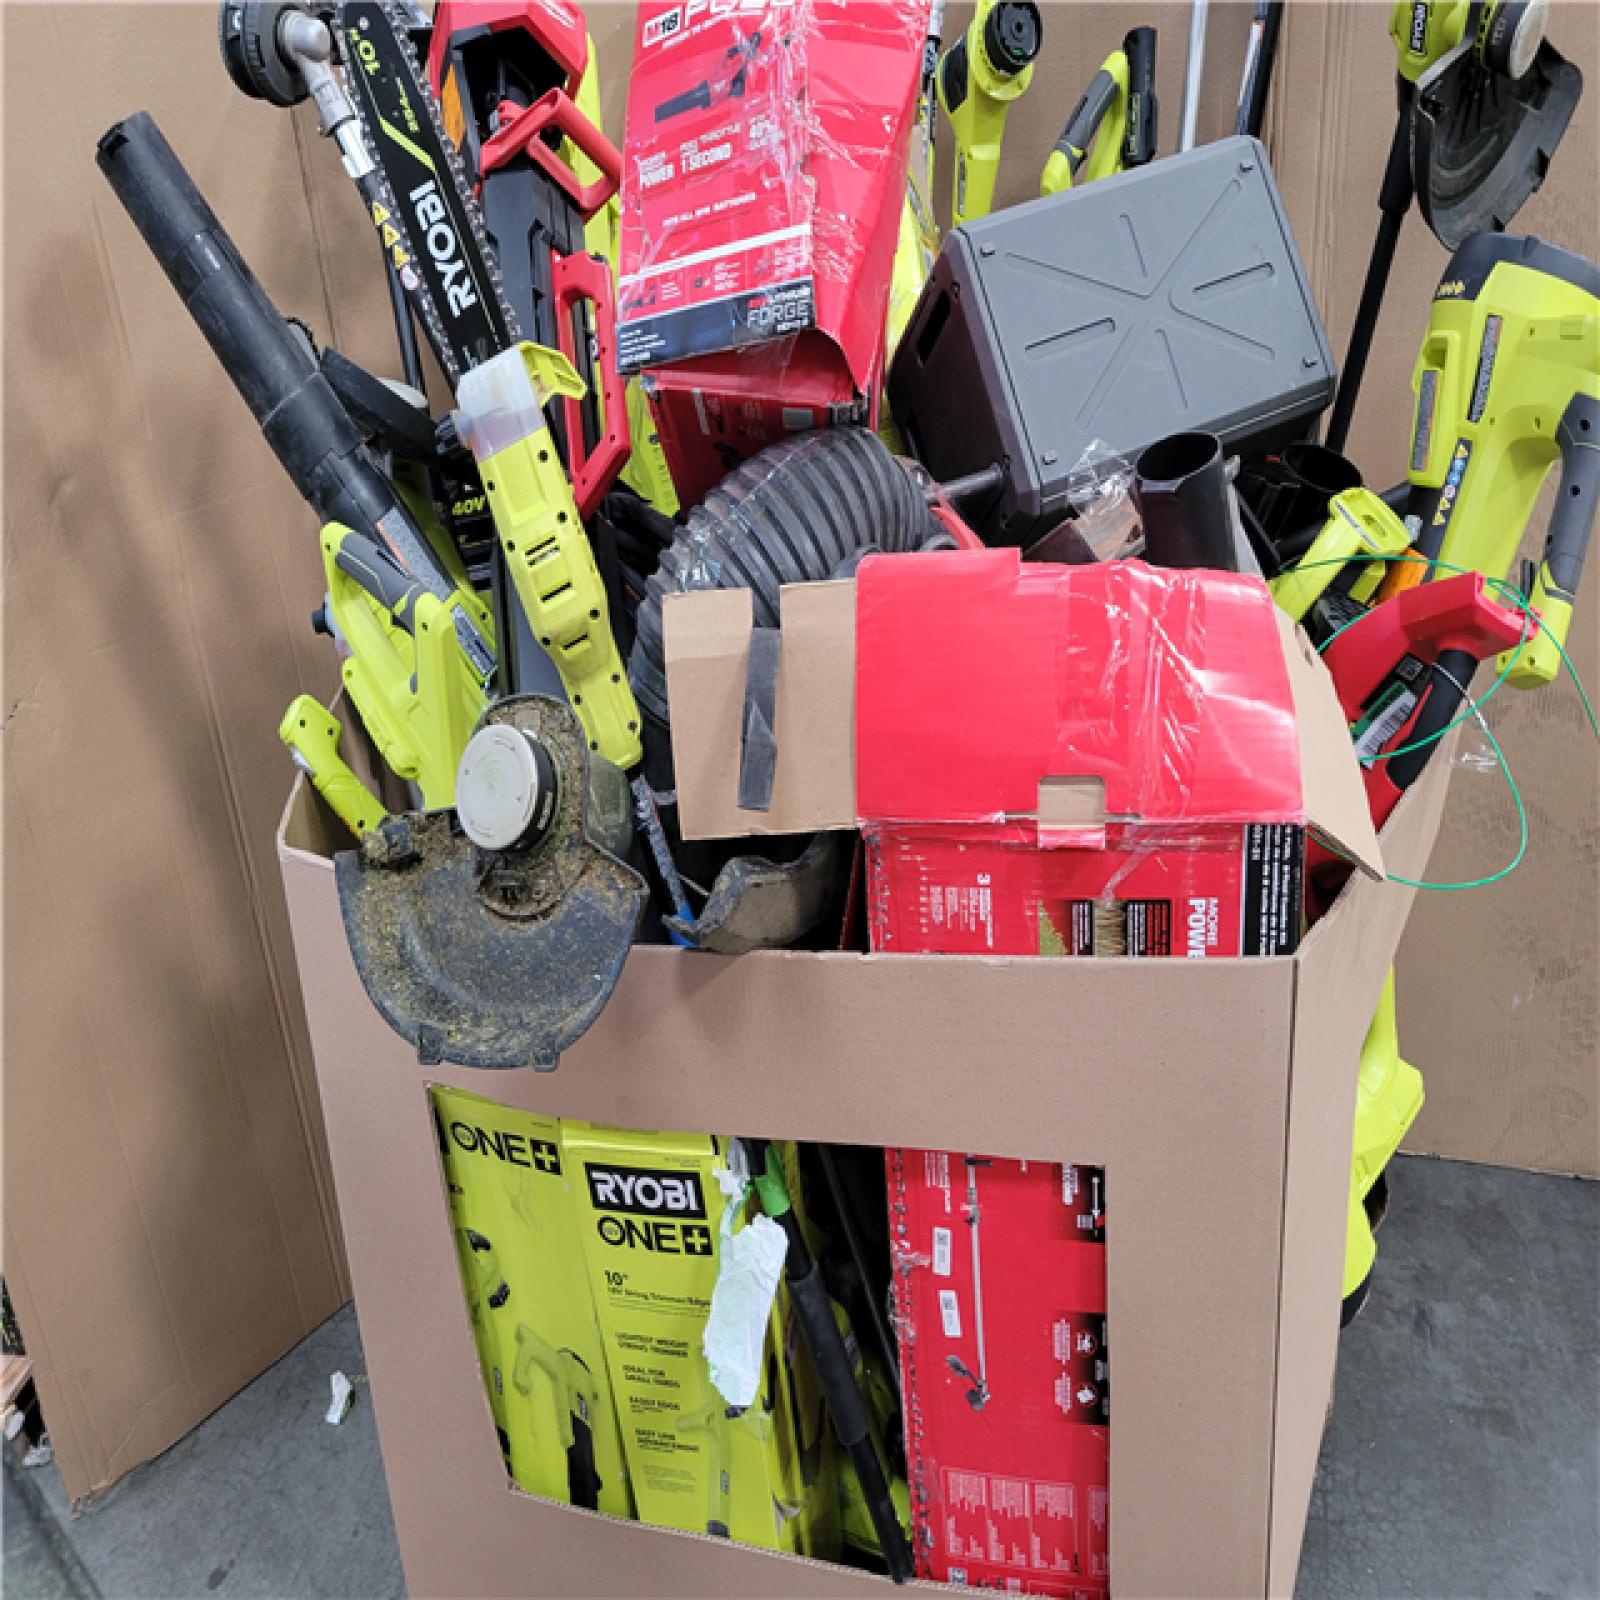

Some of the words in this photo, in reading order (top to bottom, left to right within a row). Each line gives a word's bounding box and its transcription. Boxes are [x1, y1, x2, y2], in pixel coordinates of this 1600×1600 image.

[409, 180, 476, 318] RYOBI
[748, 300, 809, 328] FORGE
[1206, 897, 1218, 946] MORE
[591, 1171, 700, 1211] RYOBI
